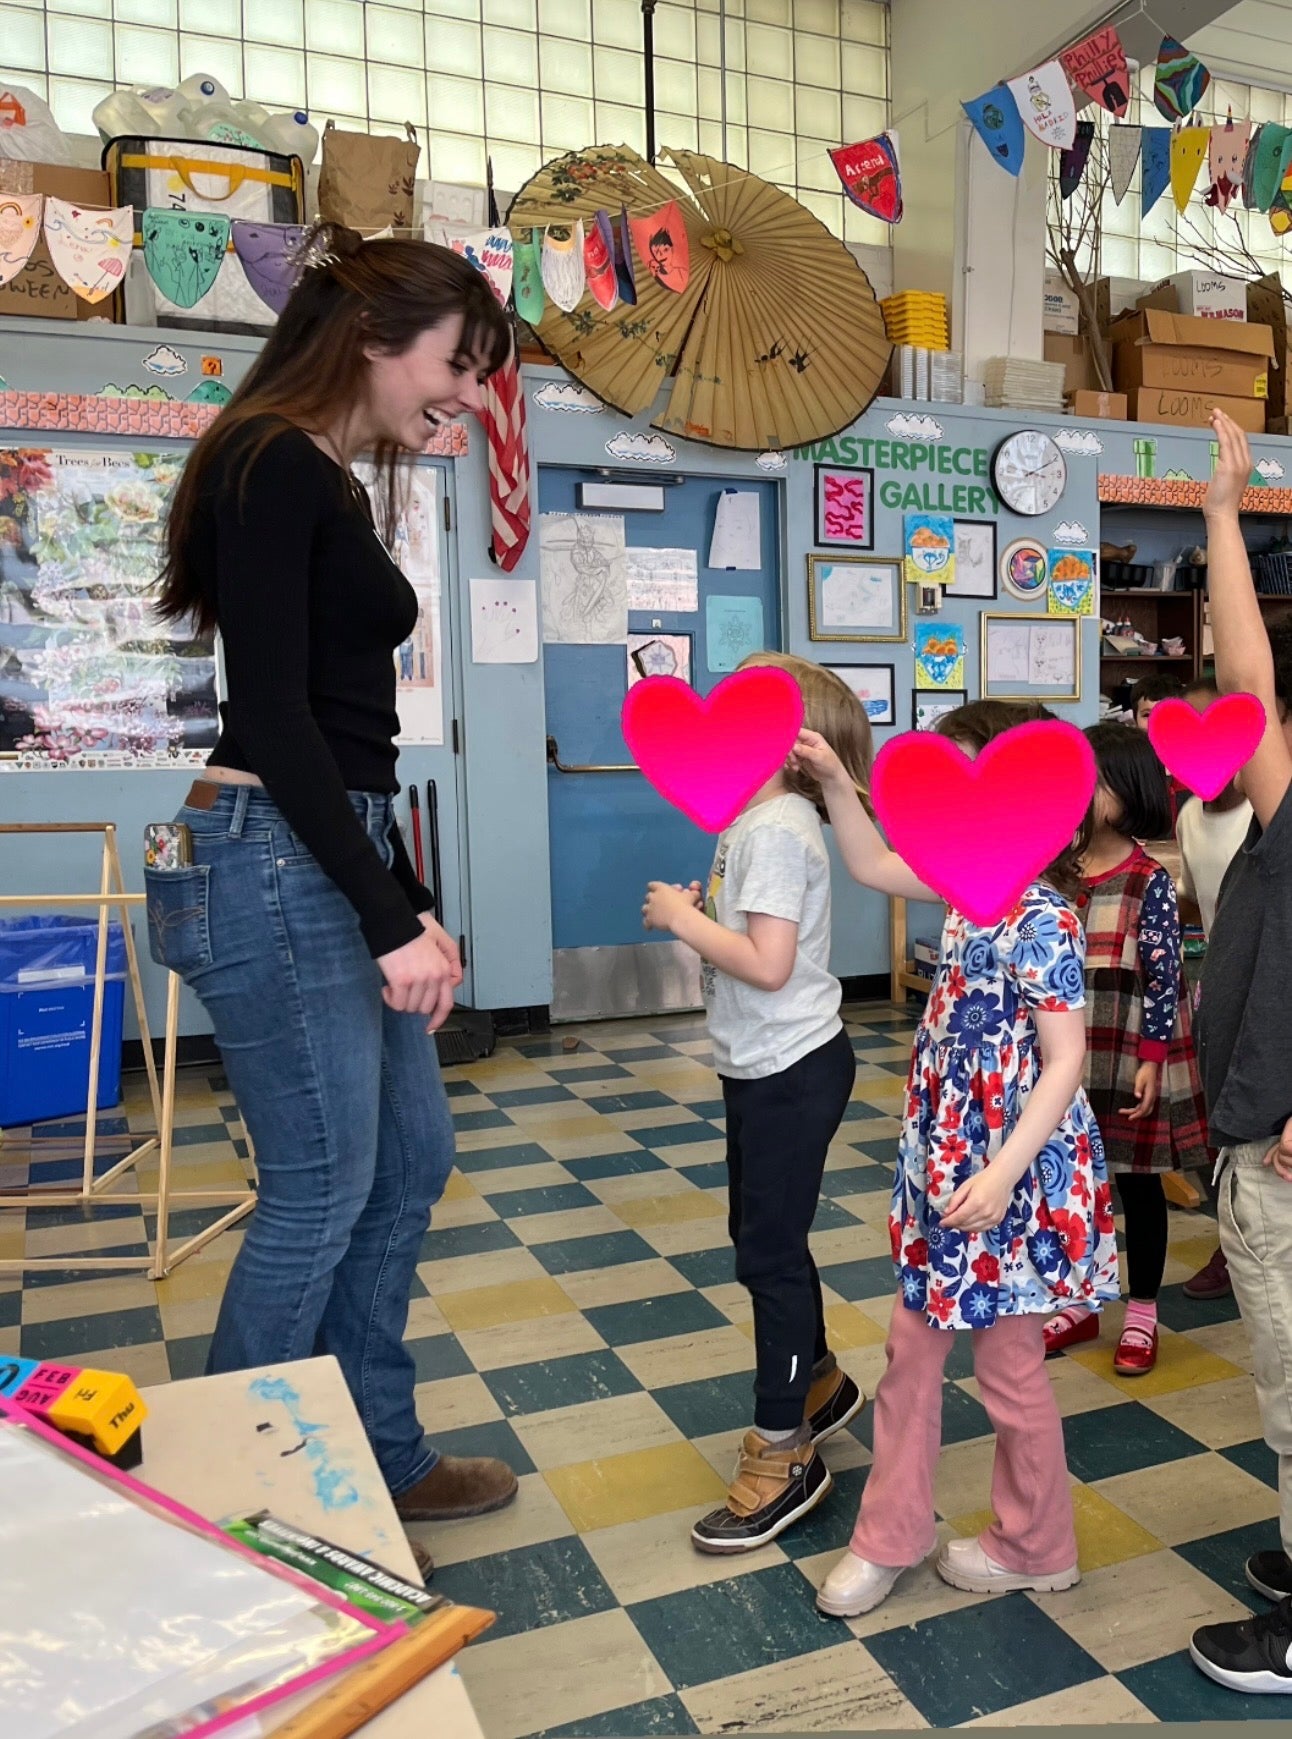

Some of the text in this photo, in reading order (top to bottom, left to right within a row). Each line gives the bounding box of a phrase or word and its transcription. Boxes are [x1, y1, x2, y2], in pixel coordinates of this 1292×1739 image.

[1195, 279, 1227, 294] LOOMS
[56, 454, 90, 466] Trees
[102, 456, 130, 467] Bees
[879, 481, 1000, 515] GALLERY
[34, 1368, 71, 1384] FEB
[108, 1402, 135, 1429] Thu
